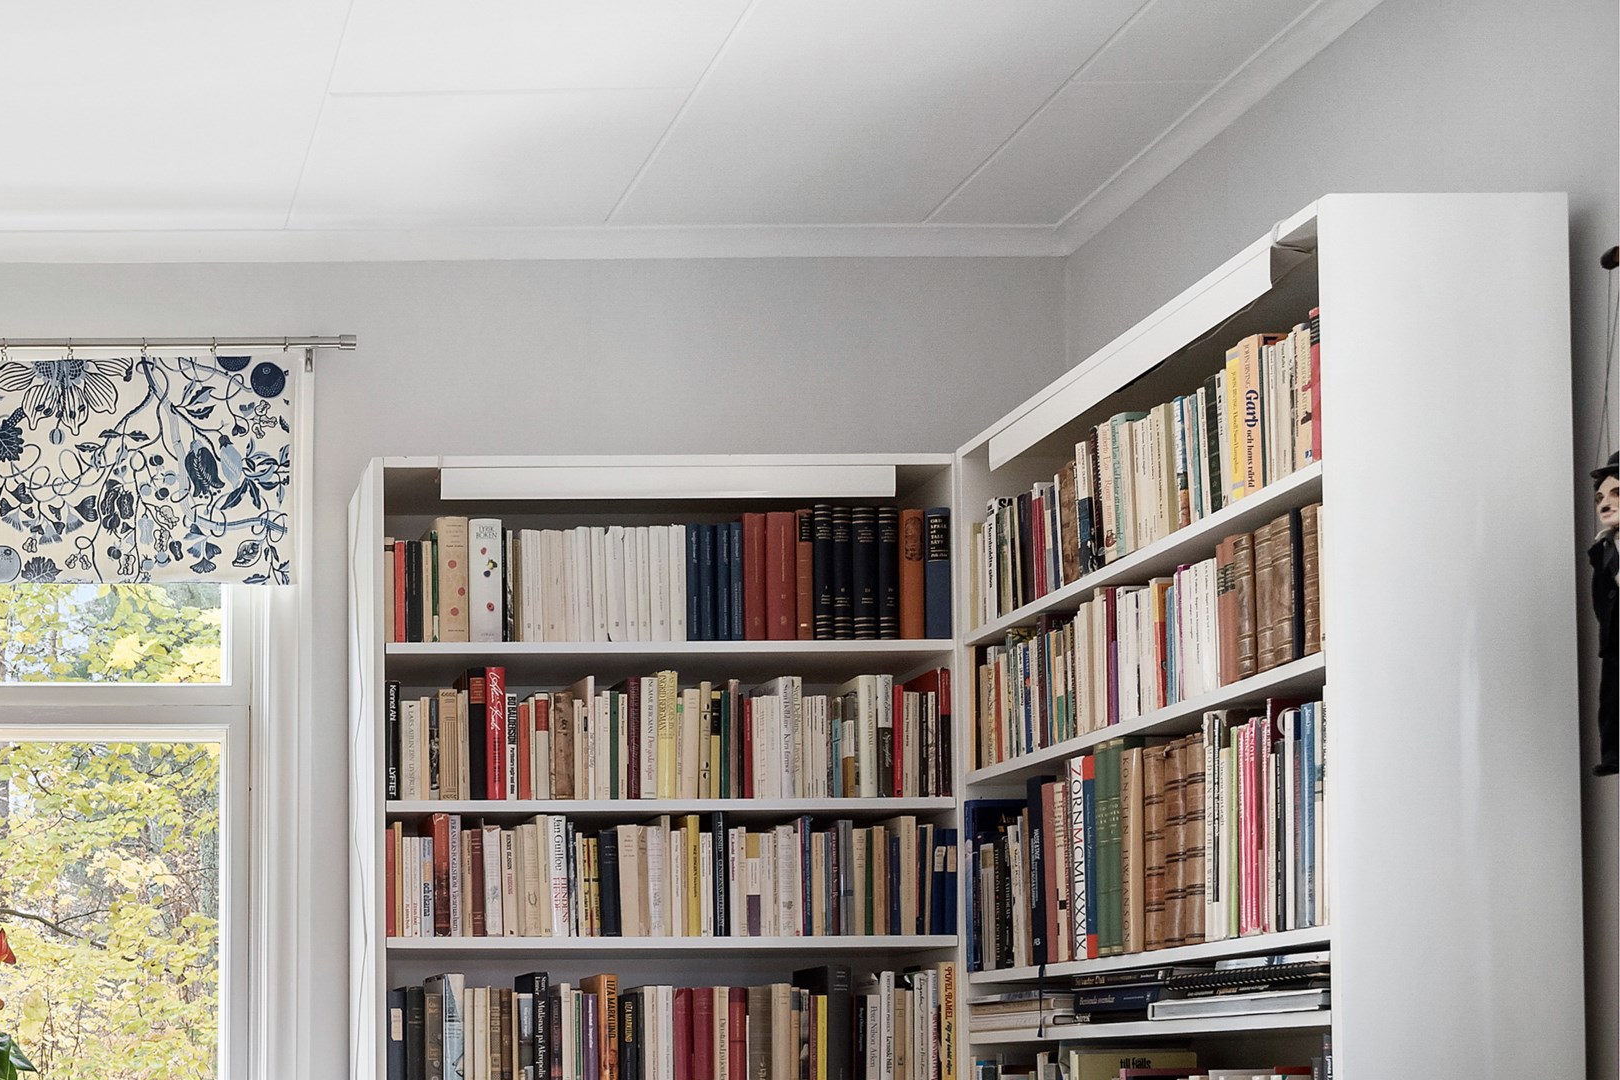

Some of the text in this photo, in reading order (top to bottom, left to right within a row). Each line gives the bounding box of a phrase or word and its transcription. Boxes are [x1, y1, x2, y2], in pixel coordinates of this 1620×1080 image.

[1245, 389, 1259, 428] Garp
[1103, 425, 1111, 454] Umberto
[1103, 456, 1111, 471] Eco
[1248, 466, 1256, 488] värld
[508, 697, 516, 745] BO BALDERSON
[646, 749, 654, 763] goda
[646, 763, 654, 780] viljan
[1122, 757, 1130, 835] KONSTEN
[553, 817, 564, 871] Jan Guillou
[423, 883, 432, 894] och
[553, 877, 561, 911] FIENDE
[423, 895, 432, 917] ekarna
[606, 980, 616, 1039] LIZA MARKLUND
[945, 993, 953, 1020] RAMEL
[536, 1035, 545, 1043] på
[538, 1045, 546, 1078] Akropolis
[1119, 1058, 1130, 1069] till
